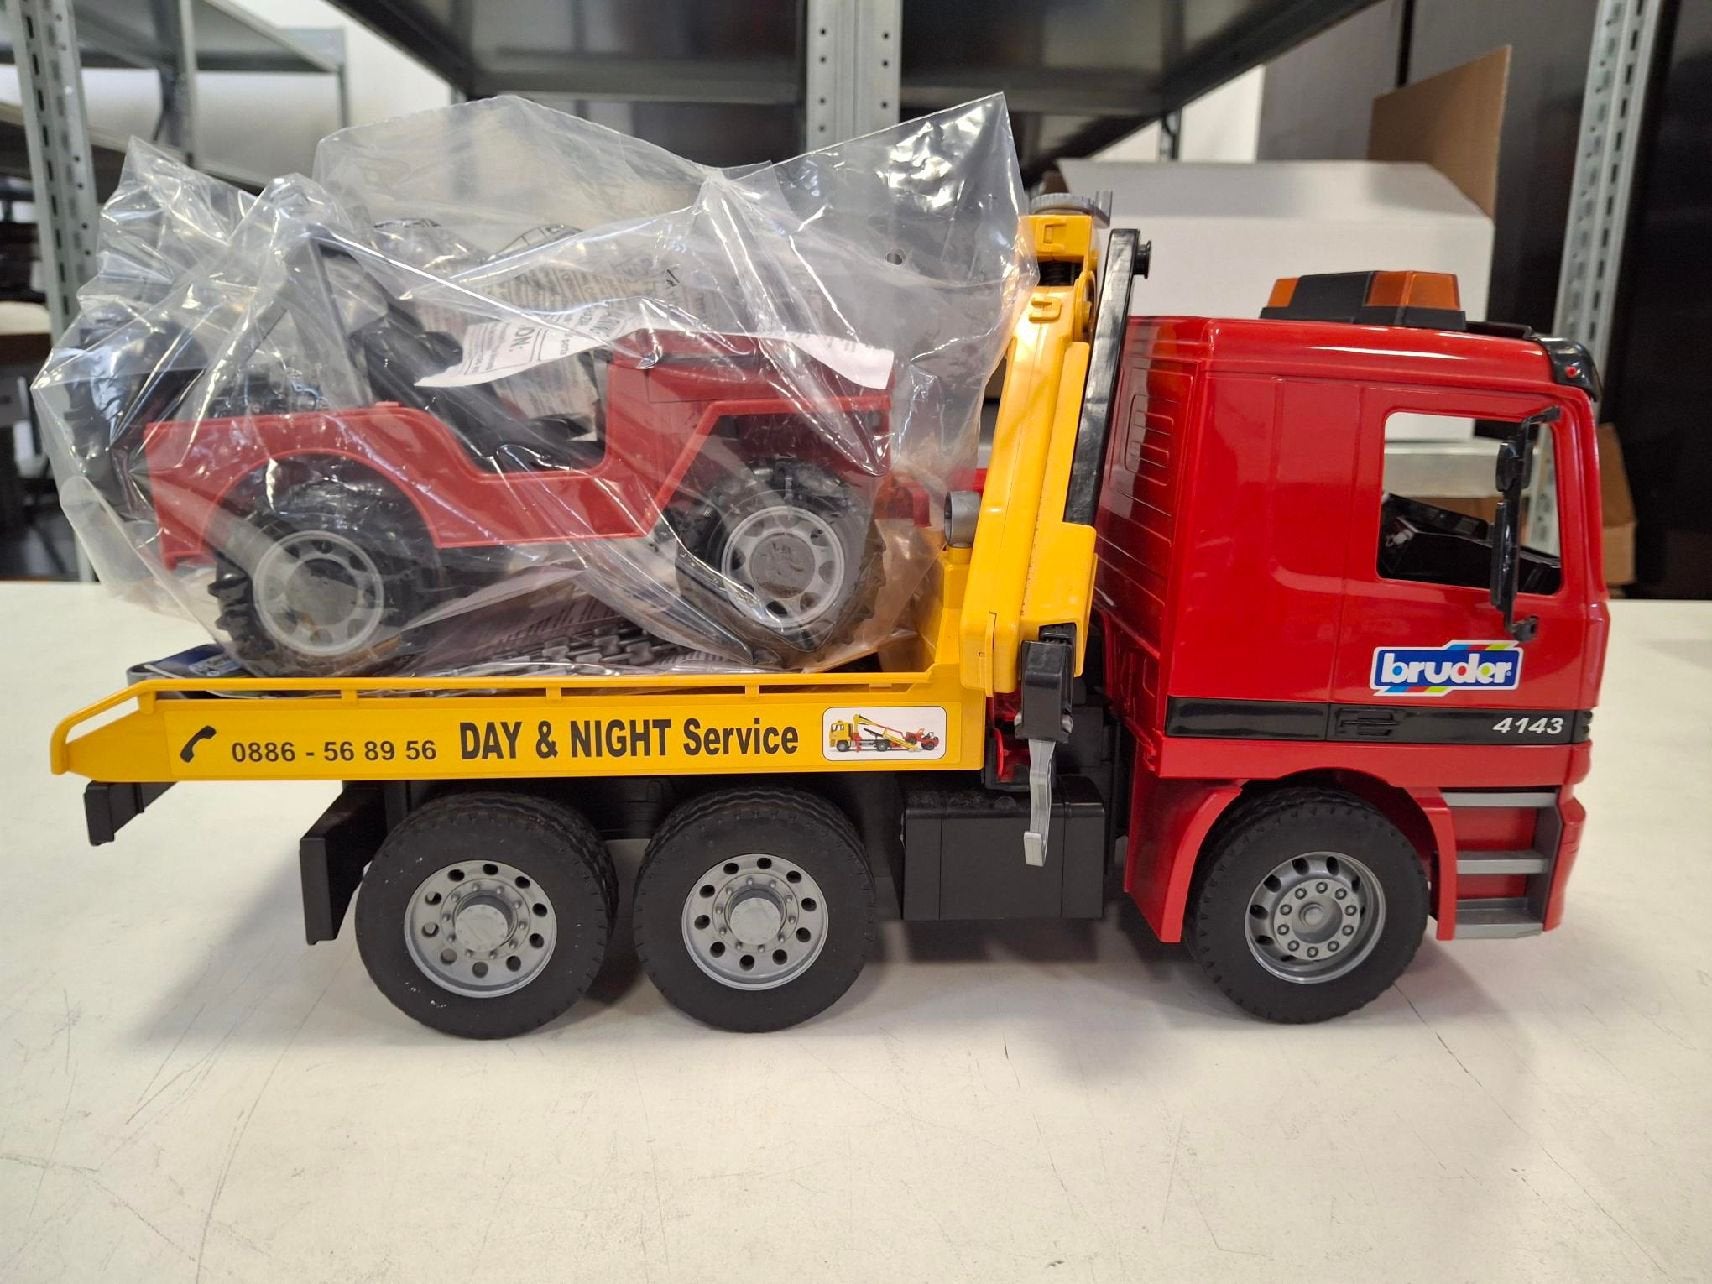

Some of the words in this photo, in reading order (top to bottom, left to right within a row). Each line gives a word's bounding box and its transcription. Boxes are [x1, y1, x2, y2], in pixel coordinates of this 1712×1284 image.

[1380, 652, 1512, 684] bruder
[459, 721, 523, 760] DAY
[535, 719, 559, 760] &
[570, 718, 672, 758] NIGHT
[683, 717, 799, 756] Service
[1492, 717, 1564, 734] 4143
[231, 742, 296, 763] 0886
[323, 741, 355, 761] 56
[364, 740, 395, 761] 89
[405, 739, 437, 760] 56
